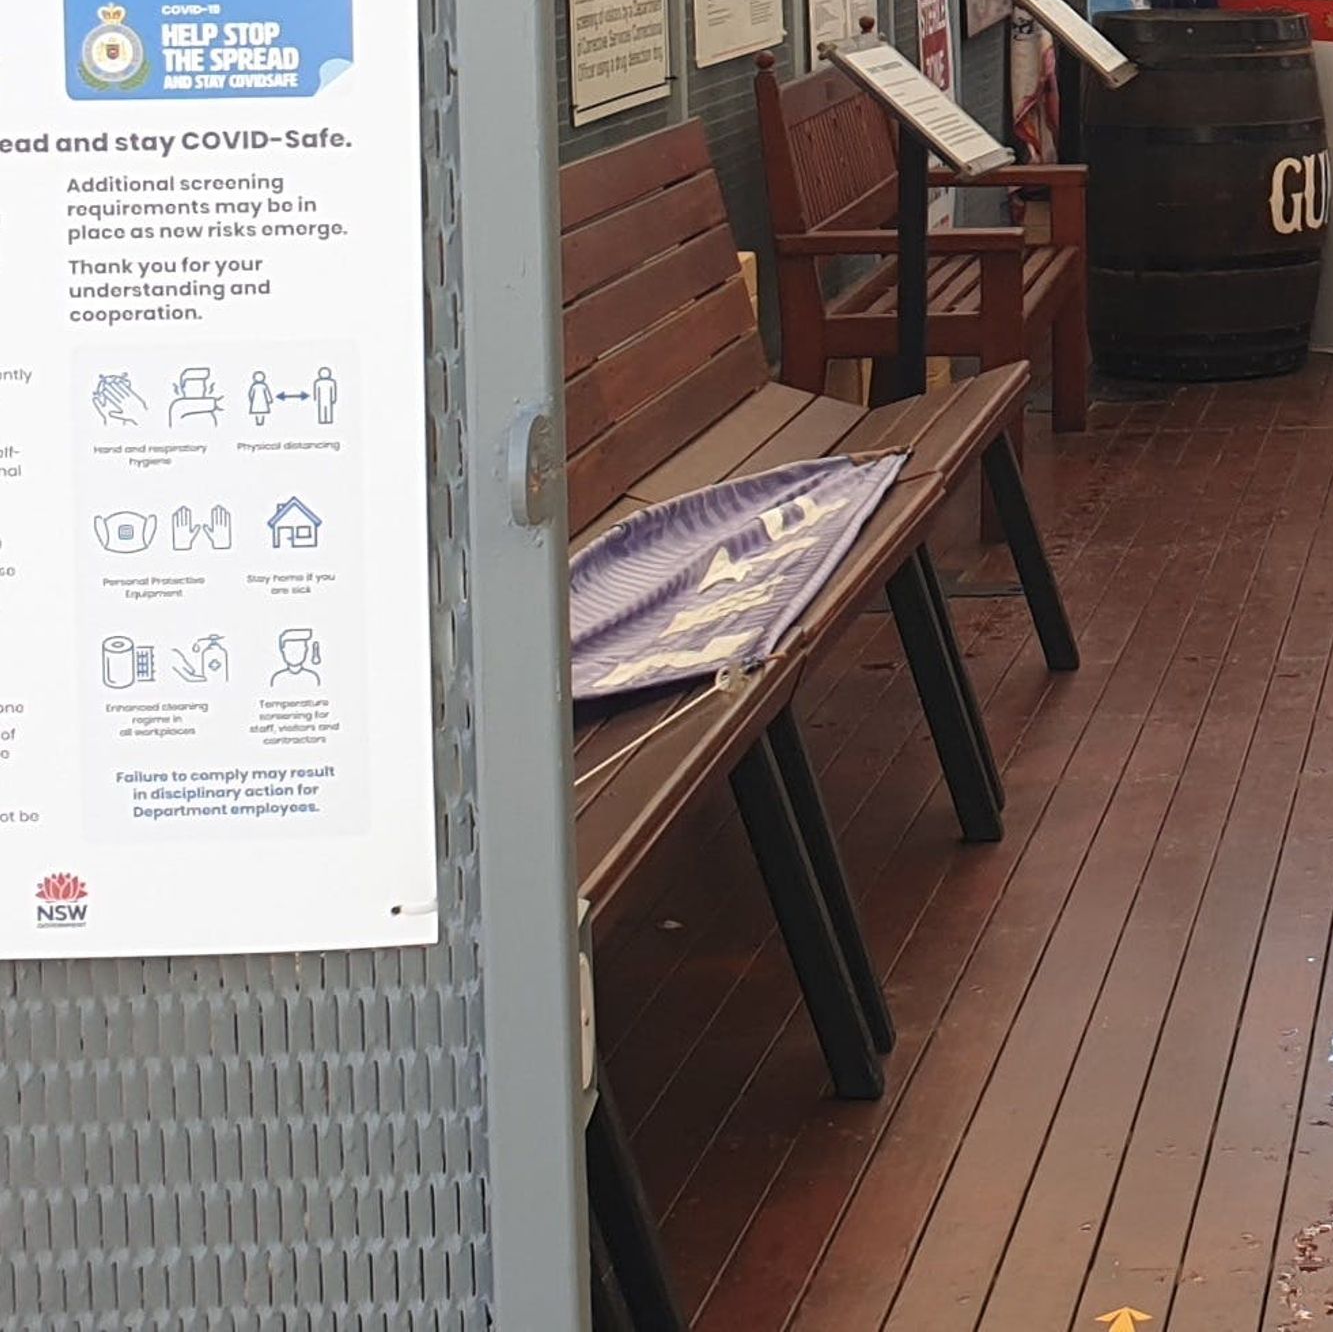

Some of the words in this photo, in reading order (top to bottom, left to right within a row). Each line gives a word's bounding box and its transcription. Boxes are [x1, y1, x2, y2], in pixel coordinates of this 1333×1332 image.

[161, 4, 220, 15] COVID-19
[161, 23, 218, 47] HELP
[223, 22, 280, 47] STOP
[163, 48, 204, 72] THE
[209, 47, 299, 72] SPREAD
[163, 75, 191, 89] AND
[195, 74, 225, 89] STAY
[229, 73, 299, 88] COVIDSAFE
[55, 132, 109, 154] and
[114, 132, 176, 157] stay
[181, 127, 353, 151] COVID-Safe.
[67, 176, 175, 194] Additional
[179, 174, 285, 195] screening
[1269, 149, 1331, 235] GU
[67, 200, 210, 220] requirements
[215, 201, 262, 220] may
[267, 197, 293, 215] be
[298, 197, 317, 214] in
[68, 222, 126, 245] place
[130, 226, 155, 240] as
[160, 224, 203, 239] new
[208, 221, 257, 238] risks
[261, 222, 348, 241] emerge.
[69, 258, 133, 276] Thank
[138, 260, 177, 280] you
[181, 256, 211, 273] for
[215, 258, 263, 278] your
[69, 281, 226, 301] understanding
[230, 279, 271, 296] and
[69, 304, 203, 326] cooperation.
[0, 368, 33, 385] ntly
[93, 445, 122, 455] Hand
[124, 444, 146, 454] and
[149, 443, 208, 456] respiratory
[236, 441, 281, 453] Physical
[283, 440, 341, 452] distancing
[129, 456, 172, 468] hygiene
[103, 576, 150, 587] Personal
[151, 574, 205, 586] Protective
[246, 573, 270, 585] Stay
[273, 573, 304, 583] home
[306, 572, 313, 582] if
[314, 573, 336, 584] you
[125, 588, 183, 600] Equipment
[270, 586, 290, 596] are
[292, 584, 312, 595] sick
[105, 702, 160, 713] Enhanced
[161, 702, 209, 713] cleaning
[259, 698, 329, 711] Temperature
[131, 715, 171, 726] regime
[173, 714, 183, 724] in
[314, 710, 330, 720] for
[119, 727, 133, 737] all
[134, 726, 196, 738] workplaces
[318, 721, 340, 732] and
[1, 728, 16, 741] of
[262, 735, 327, 746] contractors
[116, 770, 168, 783] Failure
[171, 770, 188, 783] to
[190, 769, 249, 785] comply
[252, 768, 286, 782] may
[290, 765, 335, 779] result
[133, 787, 147, 801] in
[150, 785, 242, 803] disciplinary
[244, 784, 294, 798] action
[297, 783, 319, 796] for
[20, 809, 40, 822] be
[133, 803, 228, 821] Department
[230, 801, 321, 820] employees.
[36, 904, 88, 922] NSW
